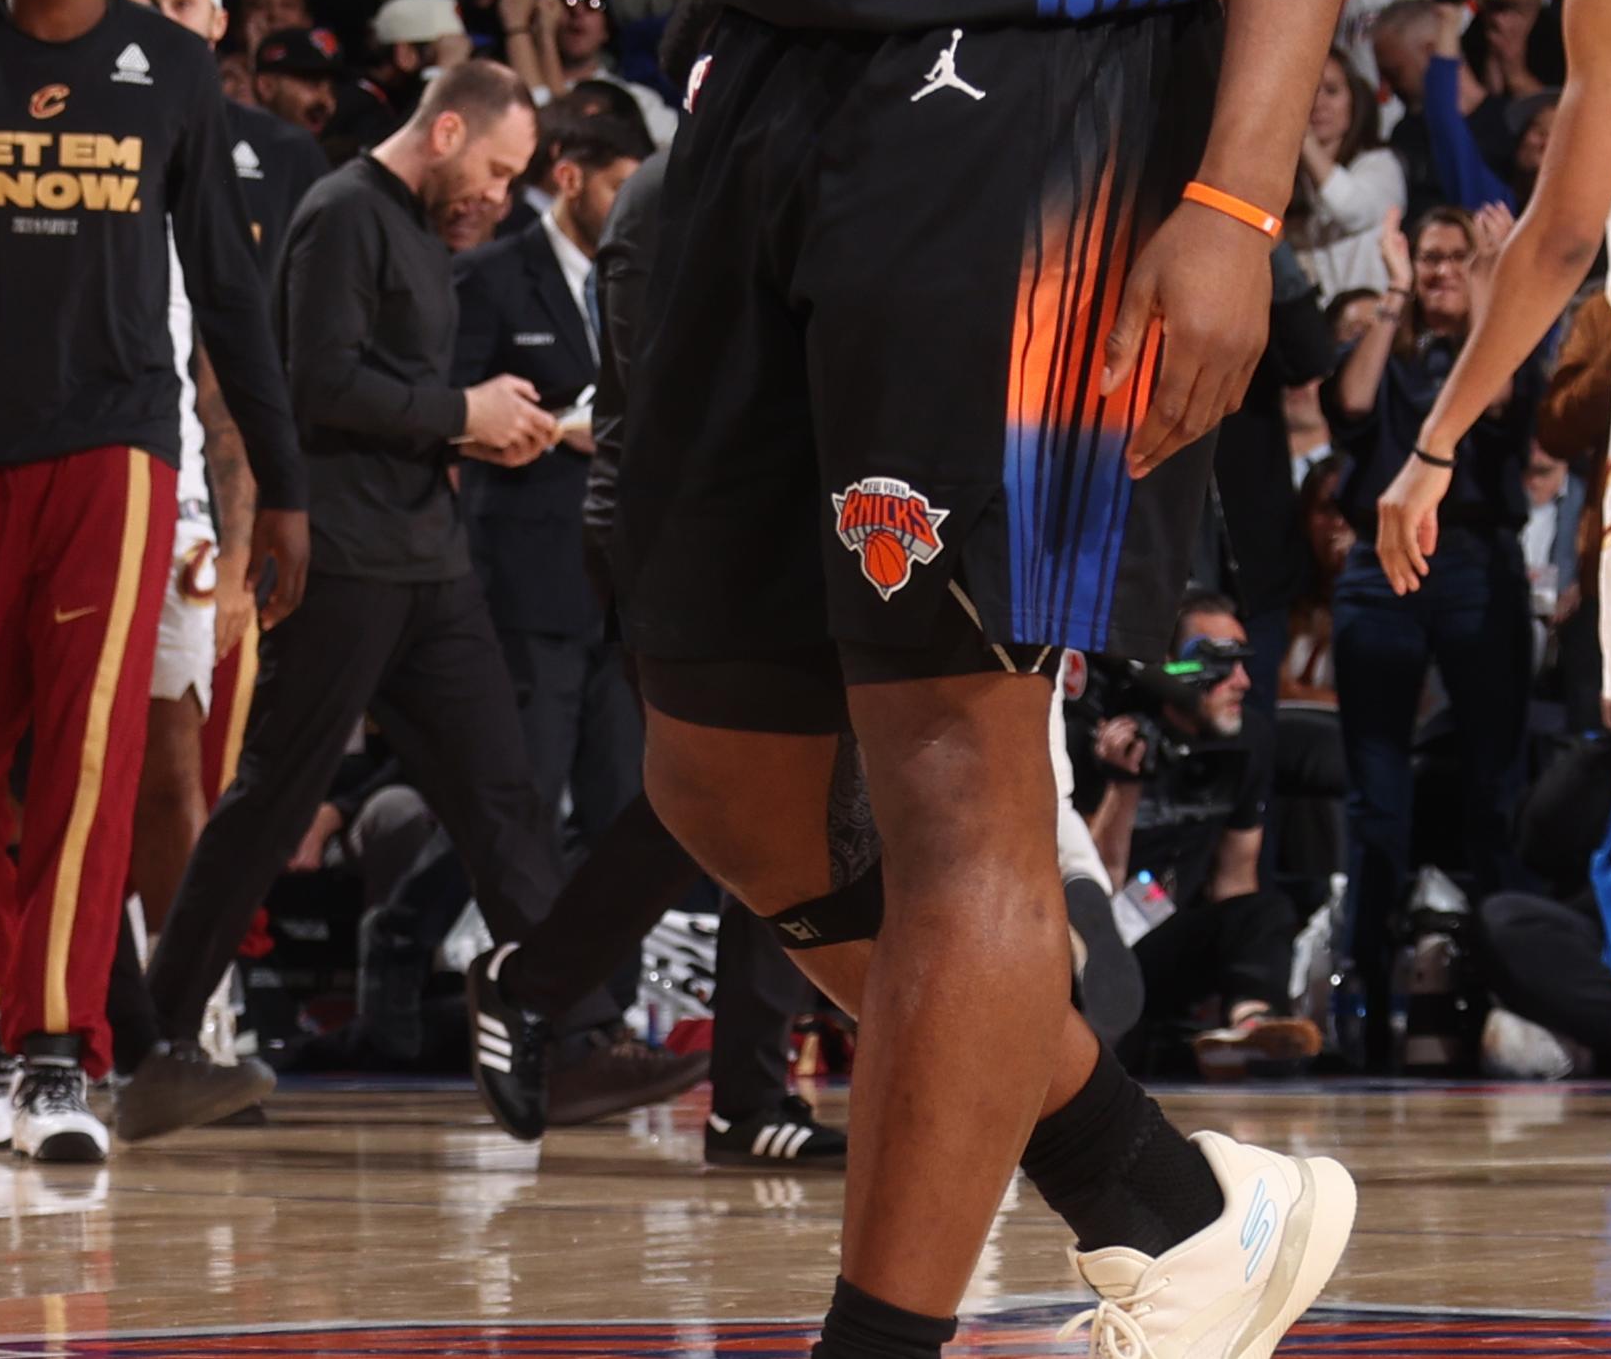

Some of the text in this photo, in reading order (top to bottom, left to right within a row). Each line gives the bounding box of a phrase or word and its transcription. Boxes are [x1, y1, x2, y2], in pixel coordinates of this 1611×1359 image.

[58, 132, 143, 172] EM
[863, 481, 908, 496] NEW YORK
[840, 489, 938, 548] KNICKS
